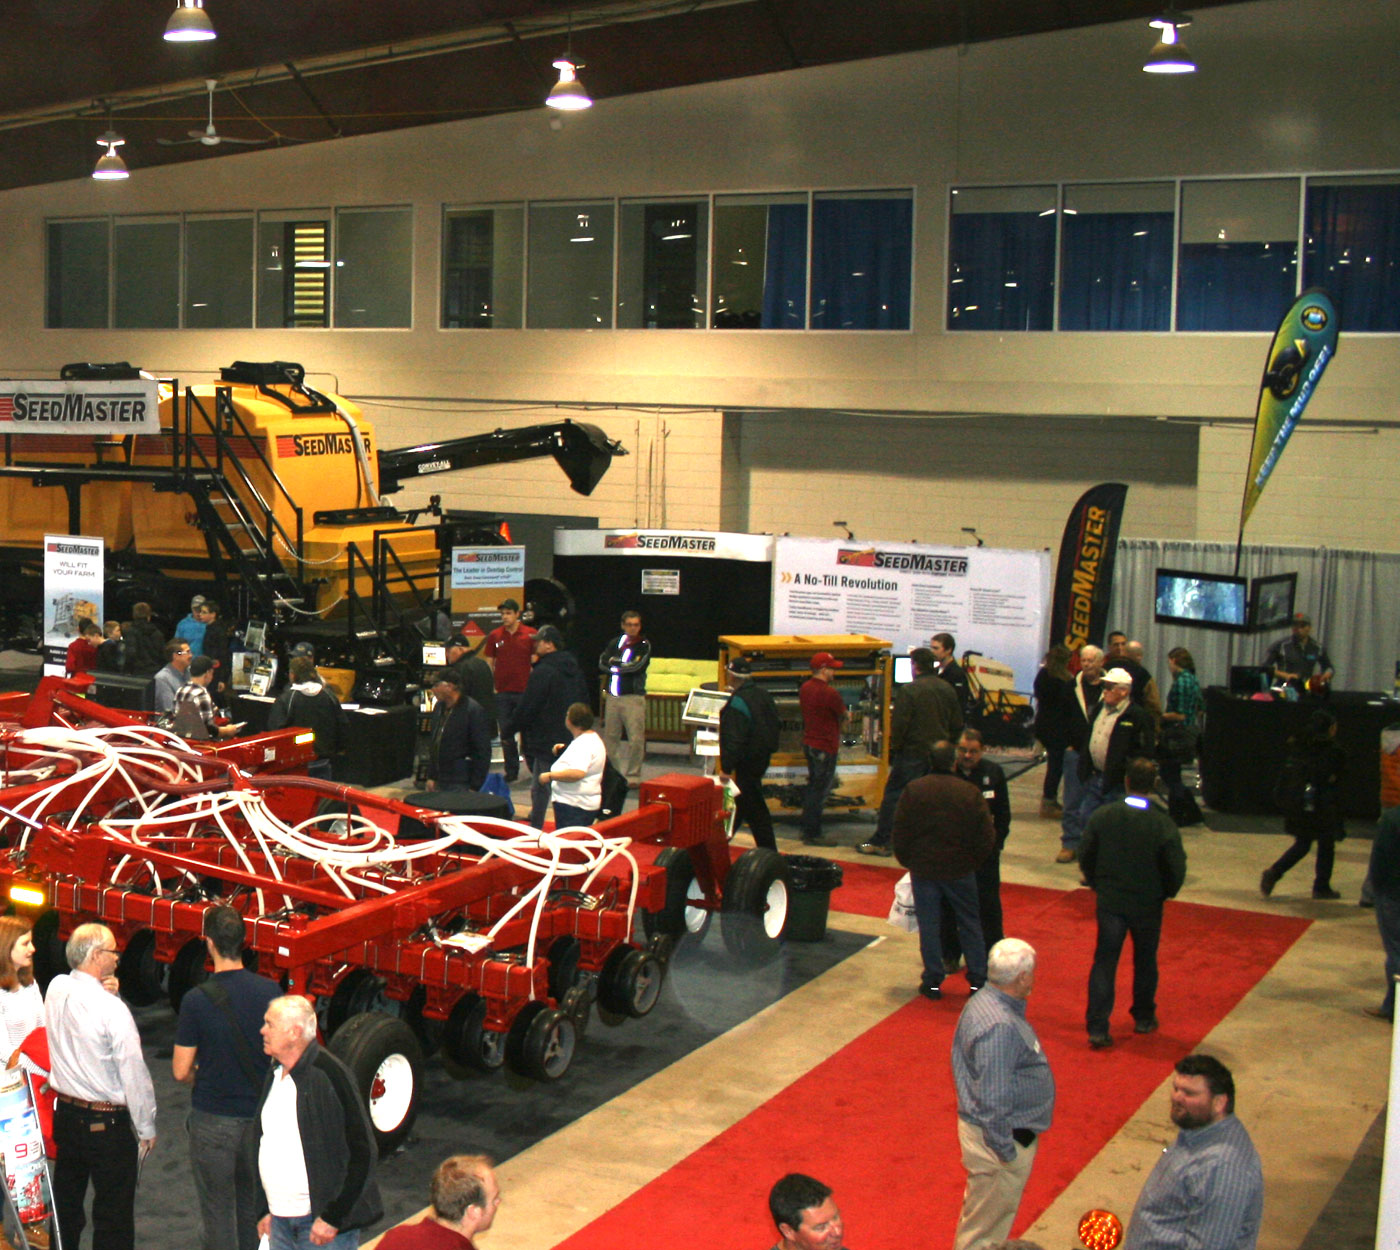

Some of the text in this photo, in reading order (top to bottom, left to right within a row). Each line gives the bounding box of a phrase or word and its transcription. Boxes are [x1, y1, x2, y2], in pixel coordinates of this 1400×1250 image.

[13, 392, 146, 422] SEEDMASTER
[1274, 416, 1294, 446] THE
[1289, 380, 1310, 417] MUD
[293, 434, 372, 457] SEEDMASR
[56, 543, 99, 556] SEEDMASTER
[637, 535, 716, 551] SEEDMASTER
[53, 568, 73, 576] YOUR
[59, 561, 76, 569] WILL
[873, 552, 968, 574] SEEDMASTER
[794, 573, 898, 591] A No-Till Revolution
[1064, 505, 1107, 652] SEEDMASTER
